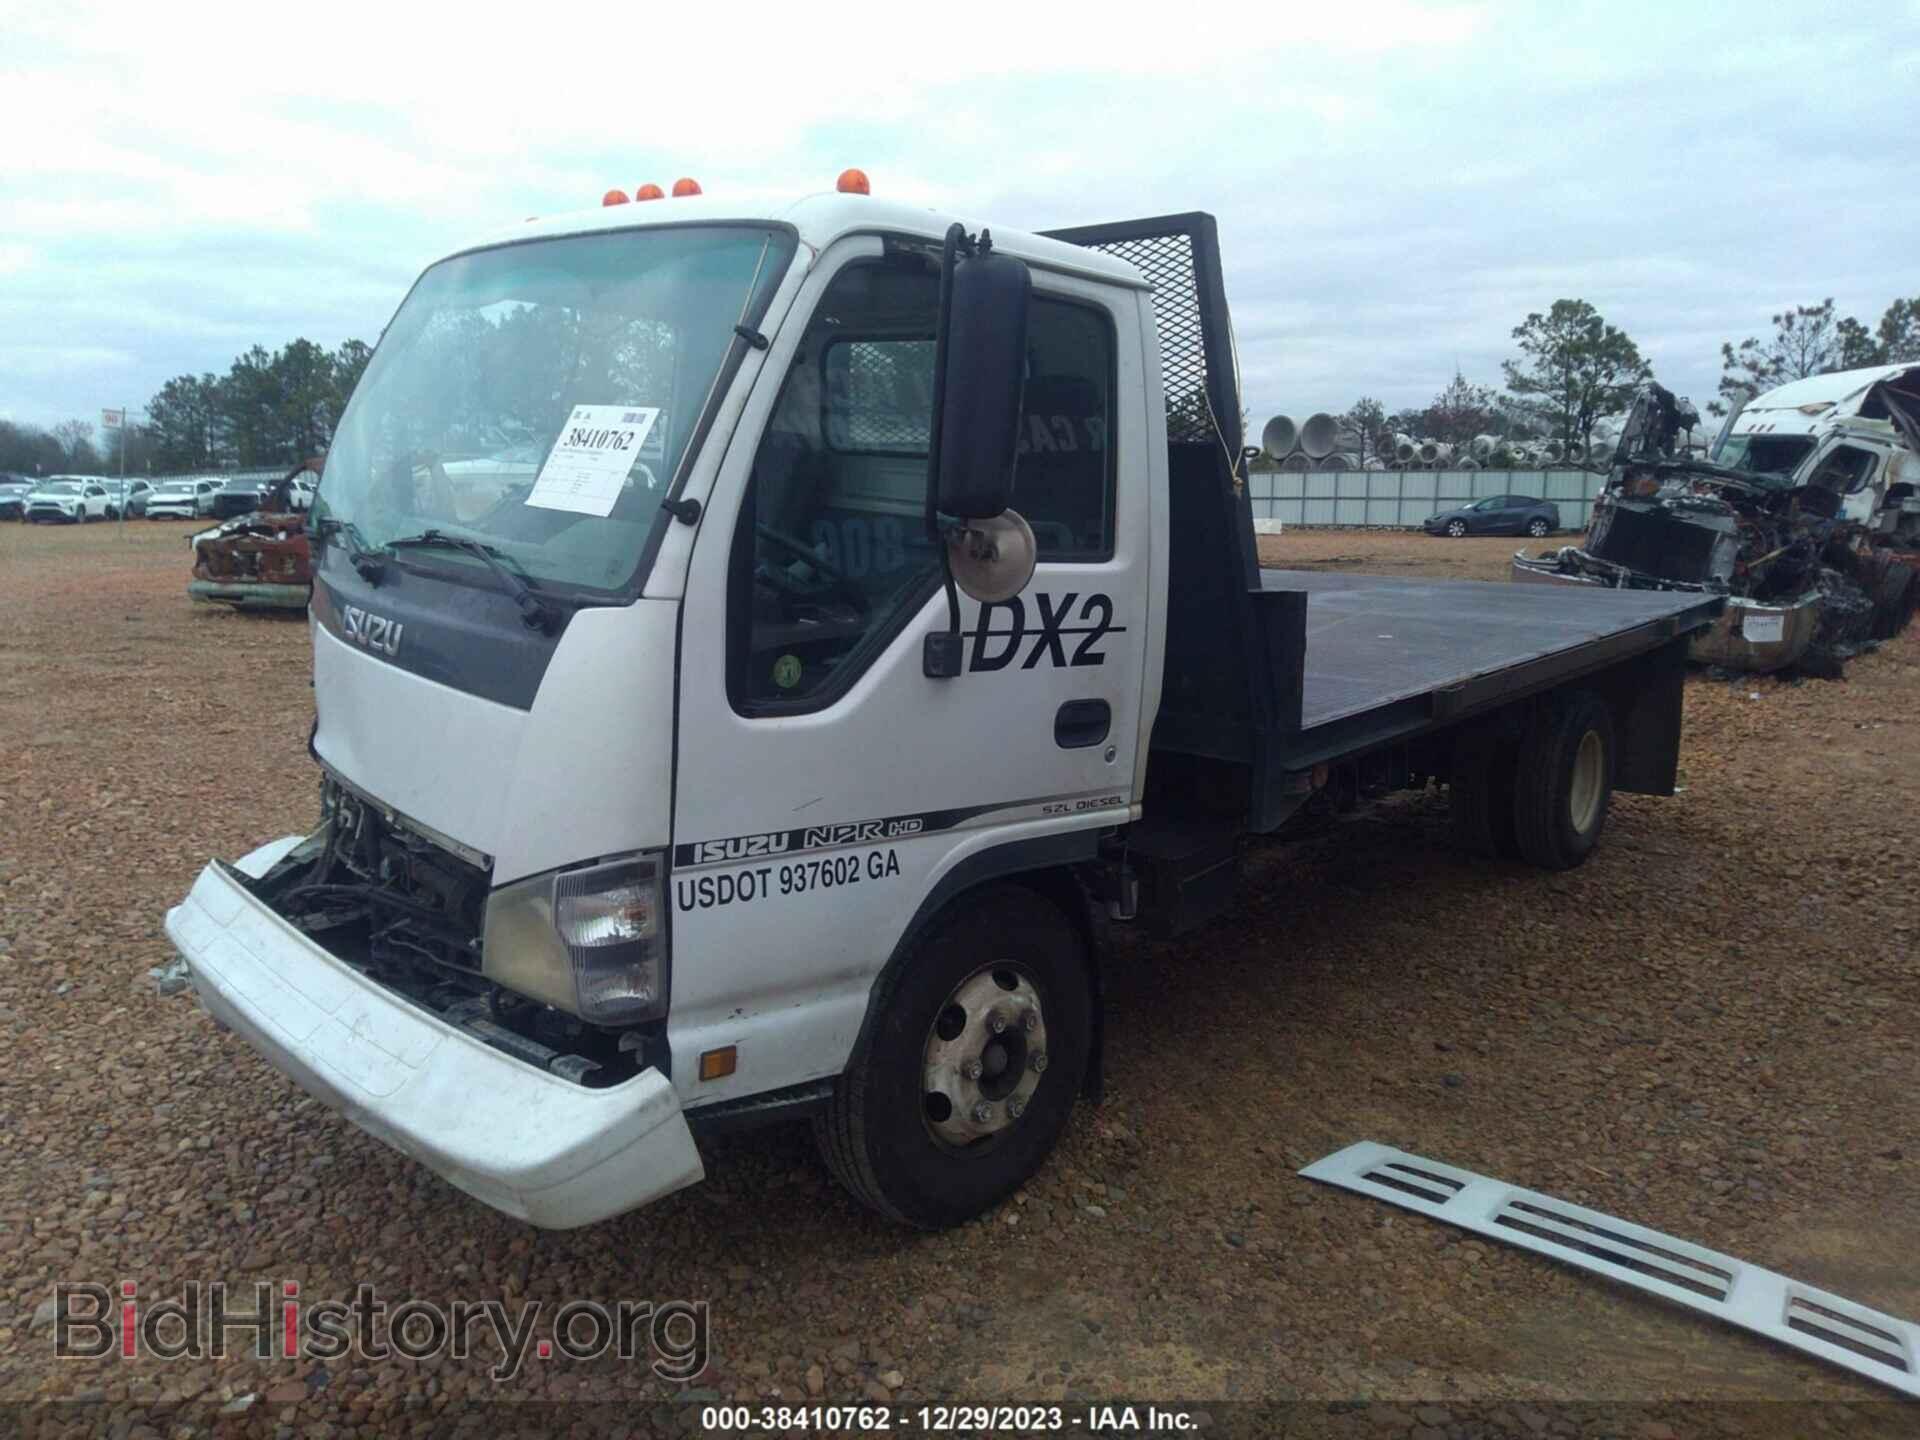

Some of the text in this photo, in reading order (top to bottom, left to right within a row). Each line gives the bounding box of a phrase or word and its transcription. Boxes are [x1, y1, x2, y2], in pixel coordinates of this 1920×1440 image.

[563, 427, 635, 450] 38410762
[343, 604, 403, 656] ISUZU
[969, 593, 1113, 672] DX2
[694, 831, 790, 864] ISUZU
[888, 818, 924, 837] HD
[678, 849, 901, 912] USDOT 937602 GA
